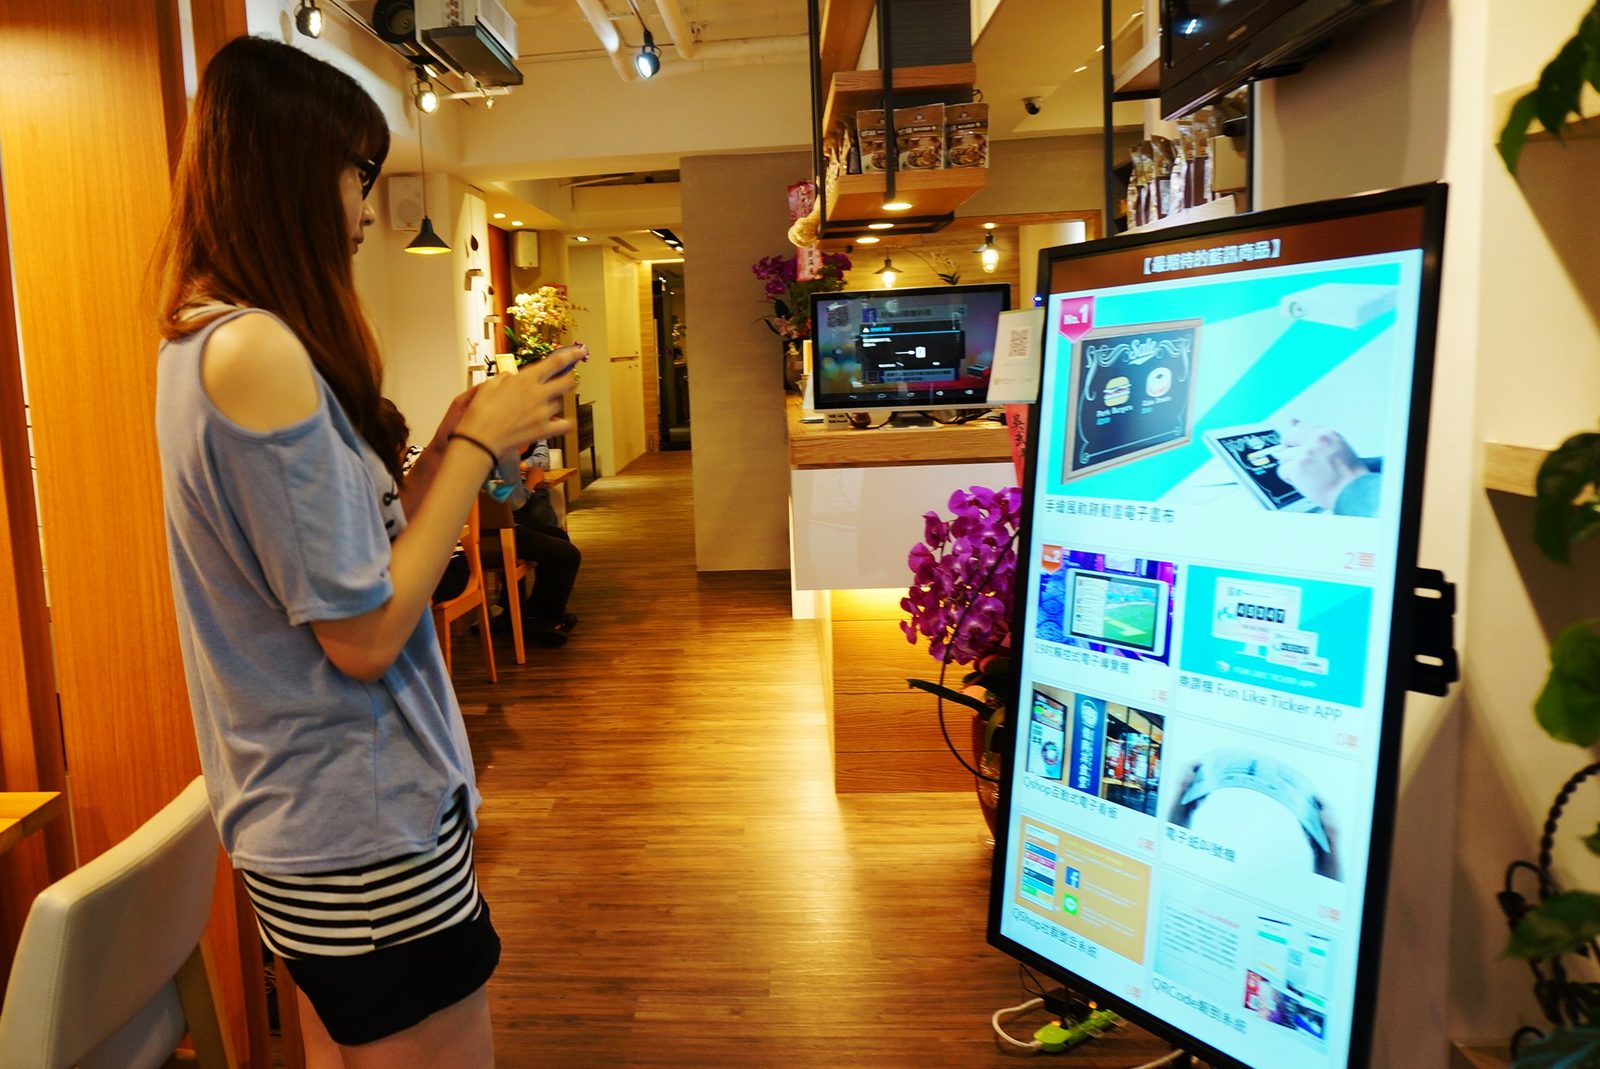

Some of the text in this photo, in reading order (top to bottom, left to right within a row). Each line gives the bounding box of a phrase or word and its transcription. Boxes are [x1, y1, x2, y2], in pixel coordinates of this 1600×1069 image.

[1216, 683, 1240, 699] Fun
[1242, 689, 1268, 706] Like
[1271, 694, 1311, 715] Ticker
[1313, 704, 1344, 721] APP
